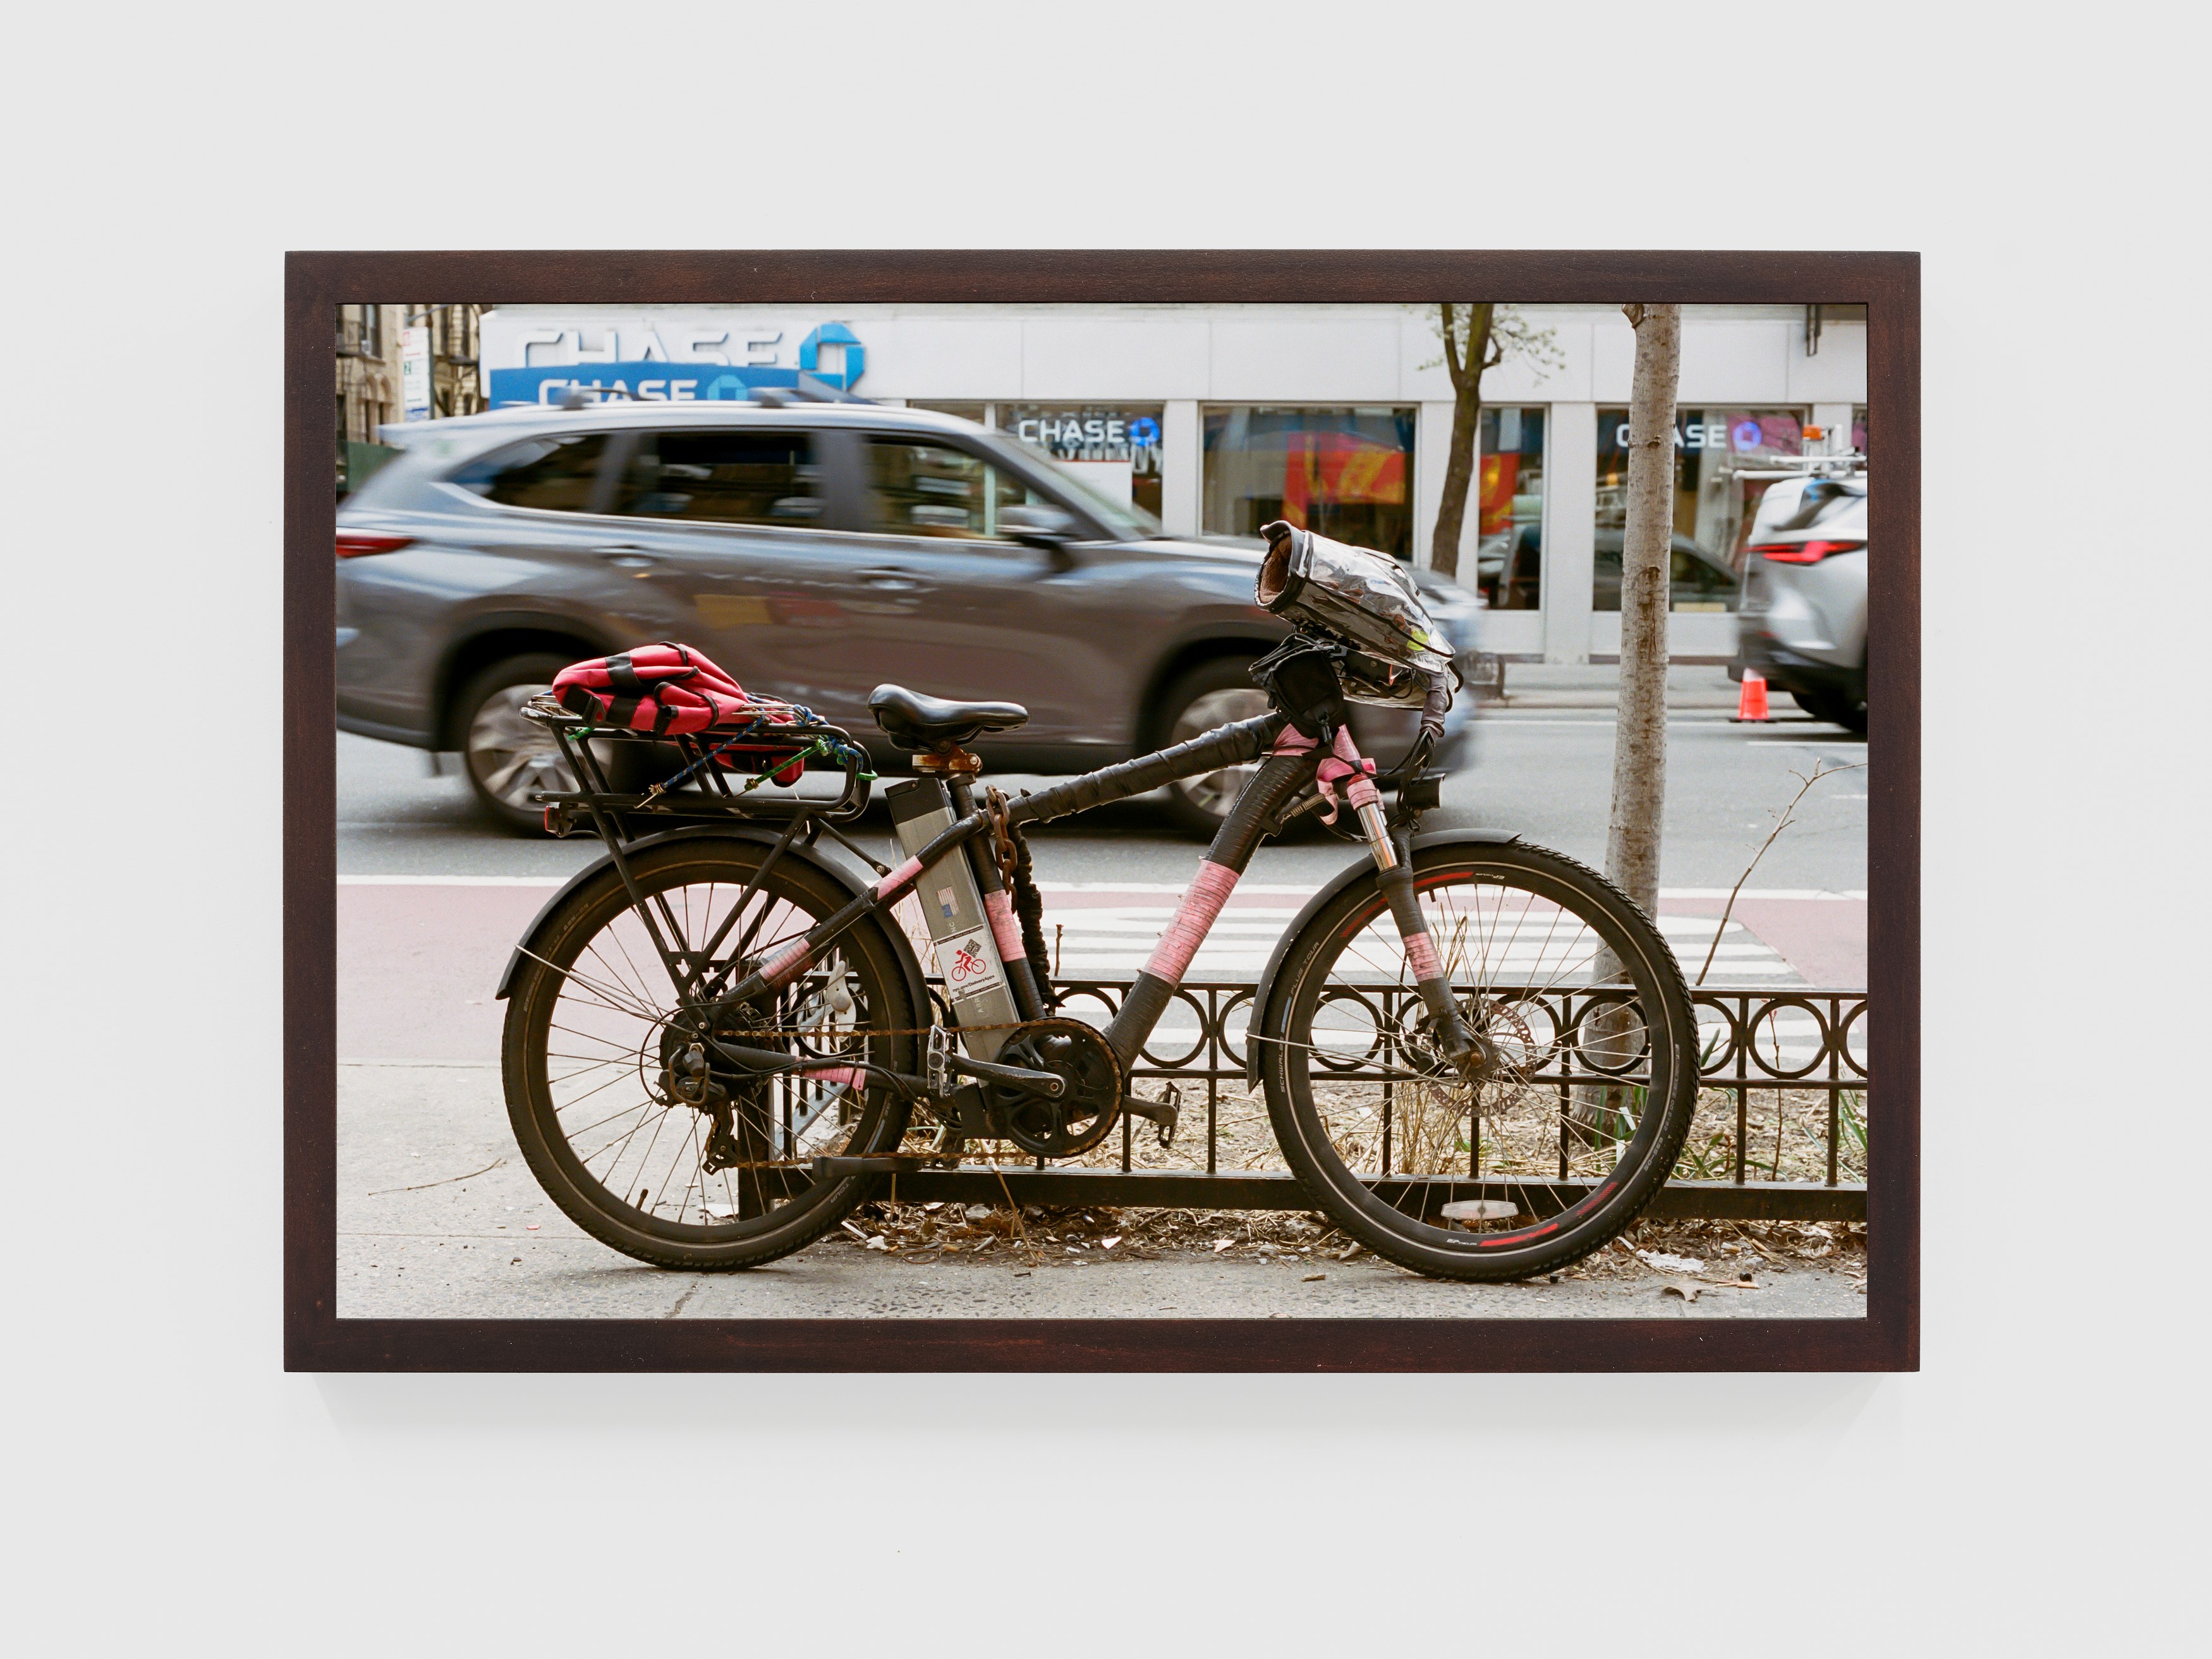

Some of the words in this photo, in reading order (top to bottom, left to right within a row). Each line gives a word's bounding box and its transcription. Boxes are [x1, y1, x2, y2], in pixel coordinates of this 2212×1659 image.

[514, 329, 782, 368] CHASE
[1018, 419, 1125, 443] CHASE
[1616, 423, 1727, 447] CASE
[1303, 941, 1320, 964] TOUR
